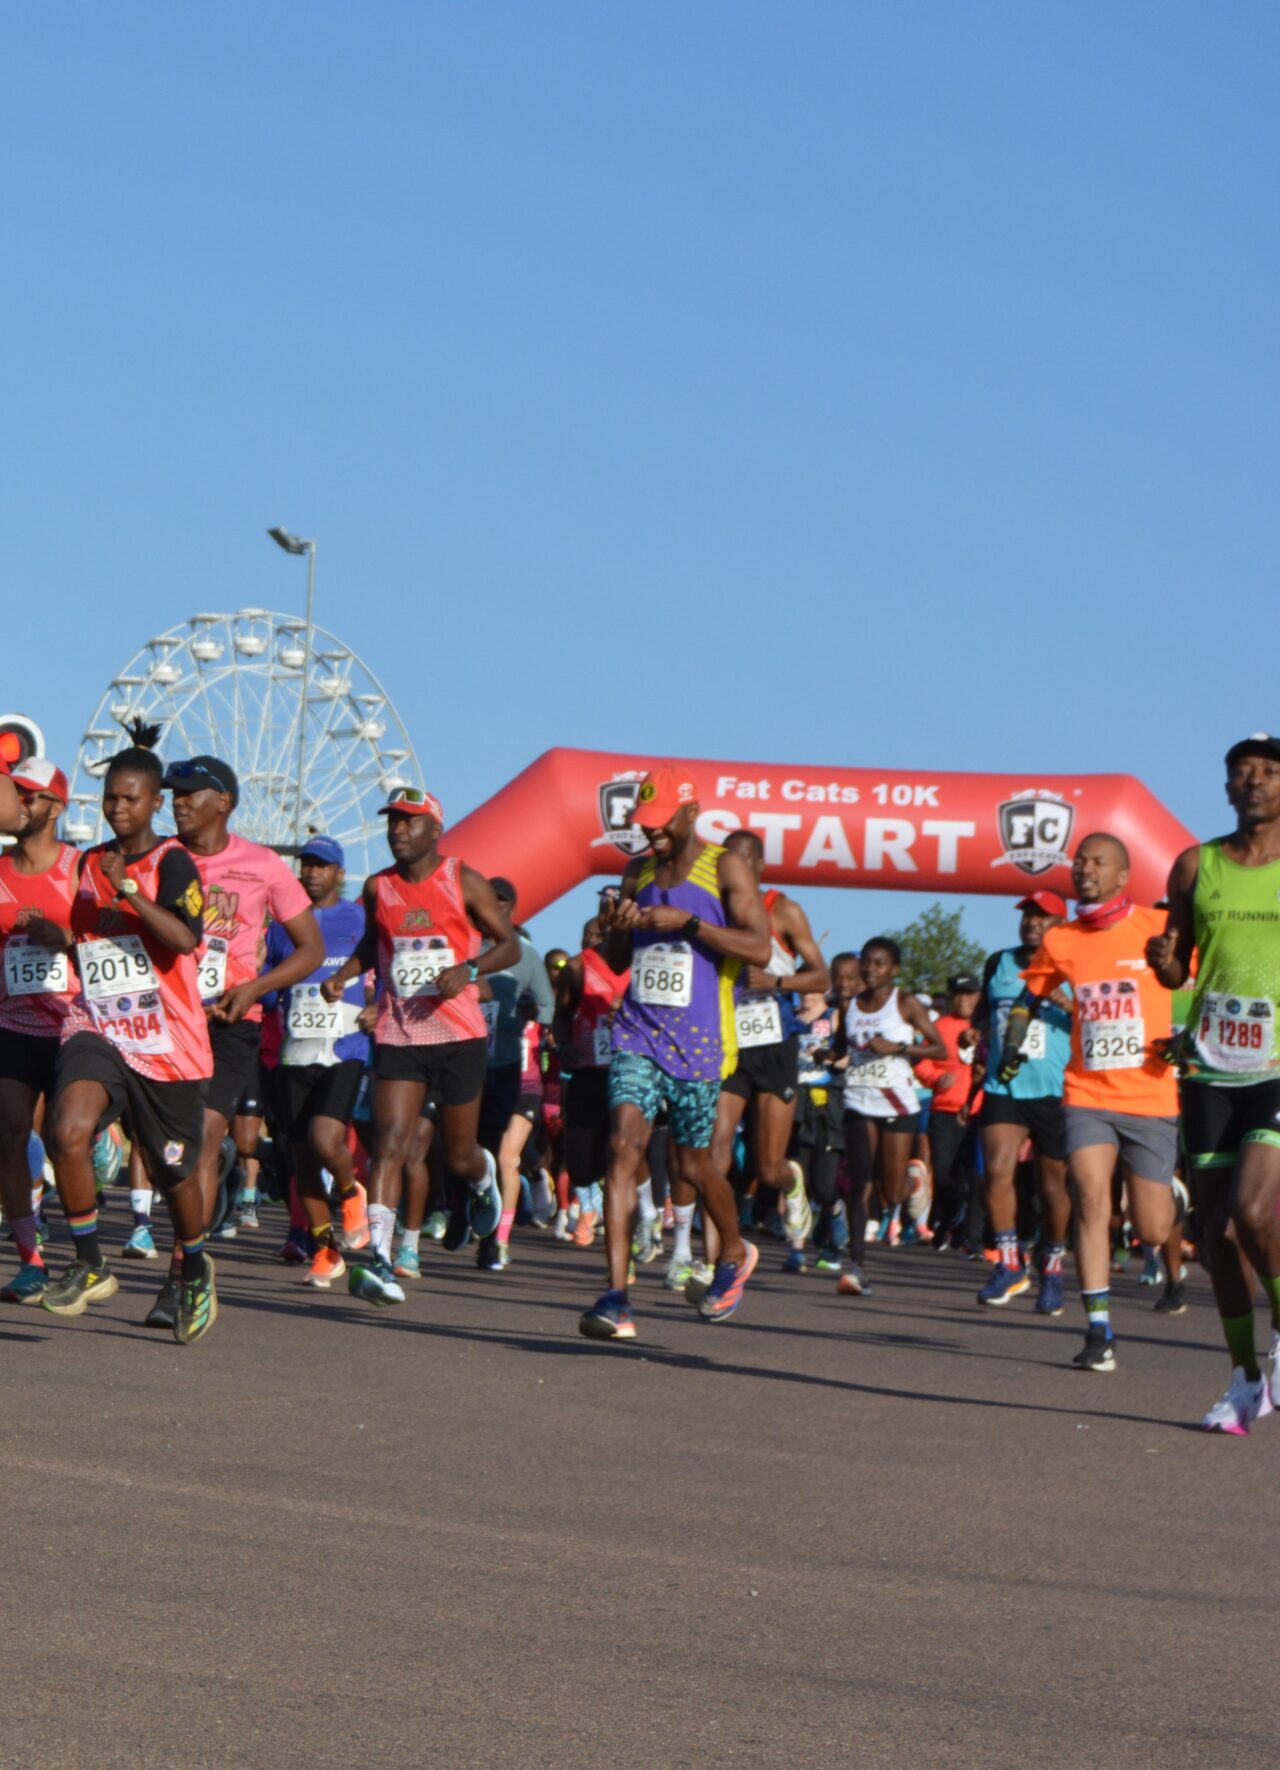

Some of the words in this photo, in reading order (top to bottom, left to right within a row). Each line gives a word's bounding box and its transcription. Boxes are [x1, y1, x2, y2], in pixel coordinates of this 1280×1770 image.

[715, 776, 771, 800] Fat
[780, 779, 861, 805] Cats
[872, 783, 941, 807] 10K
[694, 808, 977, 874] START
[1010, 814, 1060, 845] FC
[9, 960, 63, 985] 1555
[85, 952, 150, 986] 2019
[634, 967, 685, 993] 1688
[291, 1011, 338, 1029] 2327
[739, 1015, 775, 1037] 964
[1199, 1016, 1210, 1041] P
[1218, 1020, 1263, 1049] 1289
[1084, 1035, 1140, 1060] 2326
